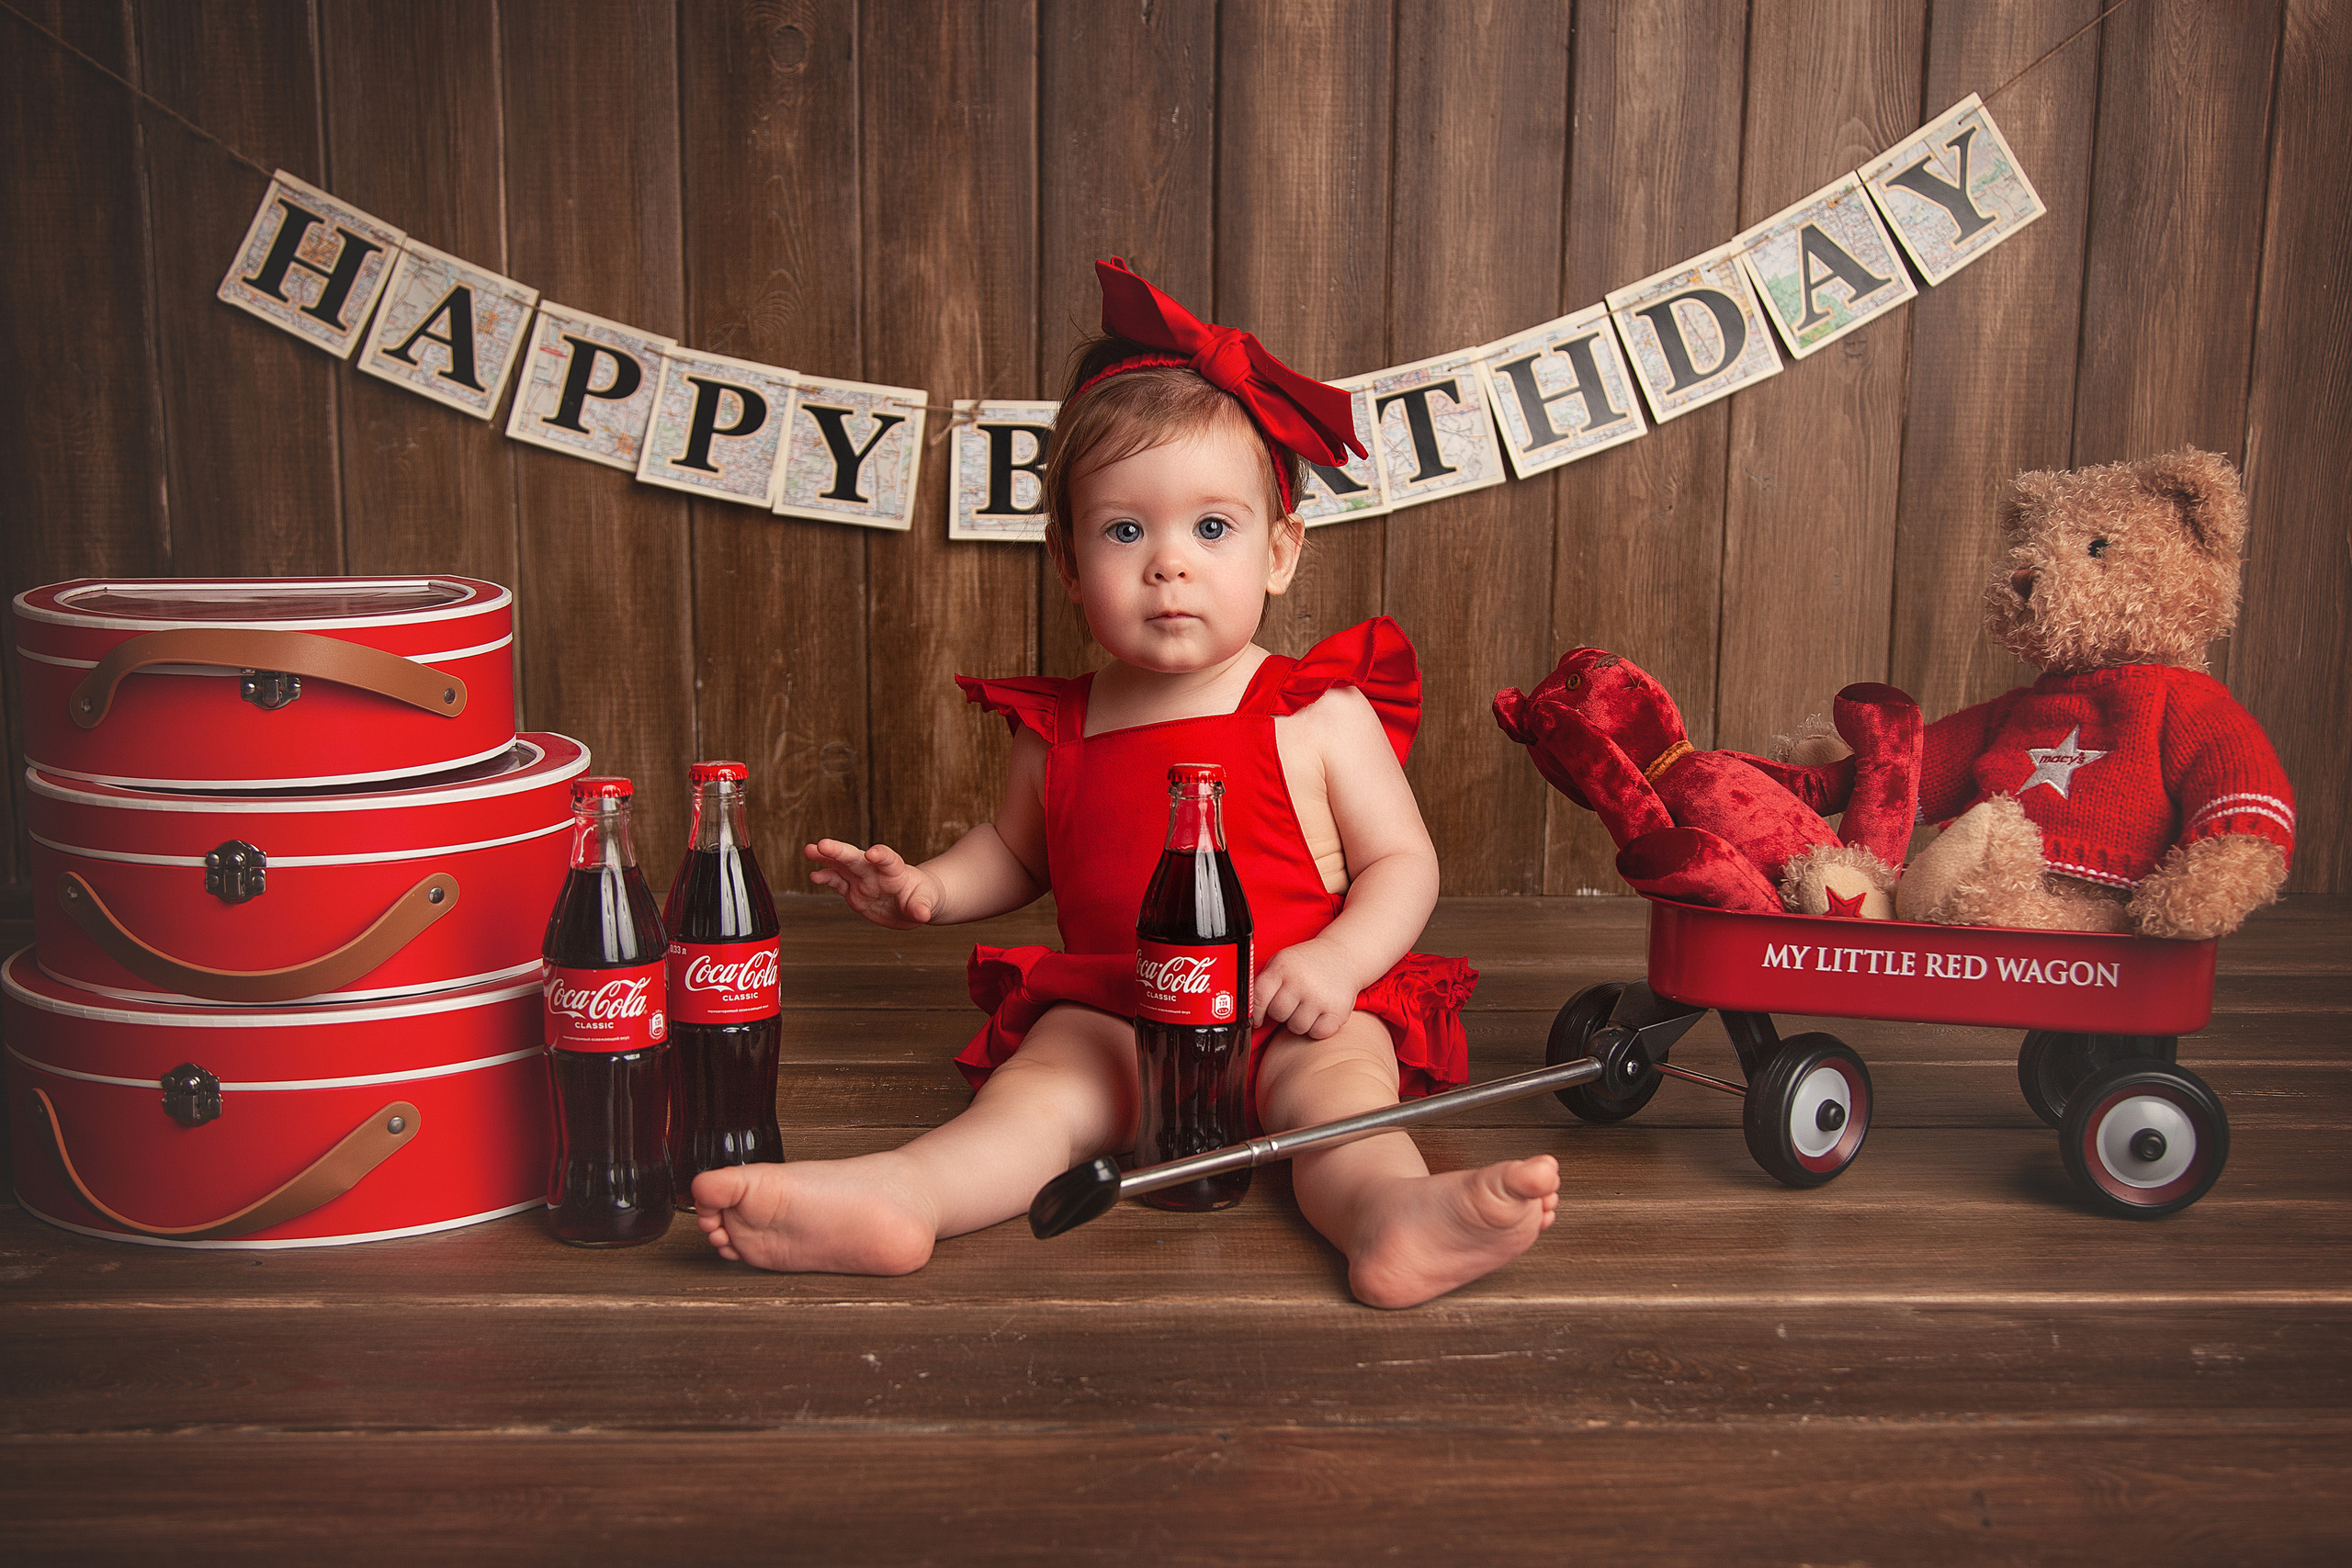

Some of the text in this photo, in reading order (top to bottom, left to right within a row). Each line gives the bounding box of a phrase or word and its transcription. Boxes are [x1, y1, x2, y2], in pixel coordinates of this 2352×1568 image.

[243, 126, 1997, 514] HAPPY BTHDAY
[684, 947, 780, 992] Coca-Cola
[1136, 948, 1217, 993] Coca-Cola
[1761, 942, 2120, 987] MY LITTLE RED WAGON
[548, 976, 652, 1020] Coca-Cola
[722, 992, 759, 1002] CLASSIC
[1147, 991, 1177, 1002] CLASSIC
[574, 1021, 615, 1030] CLASSIC
